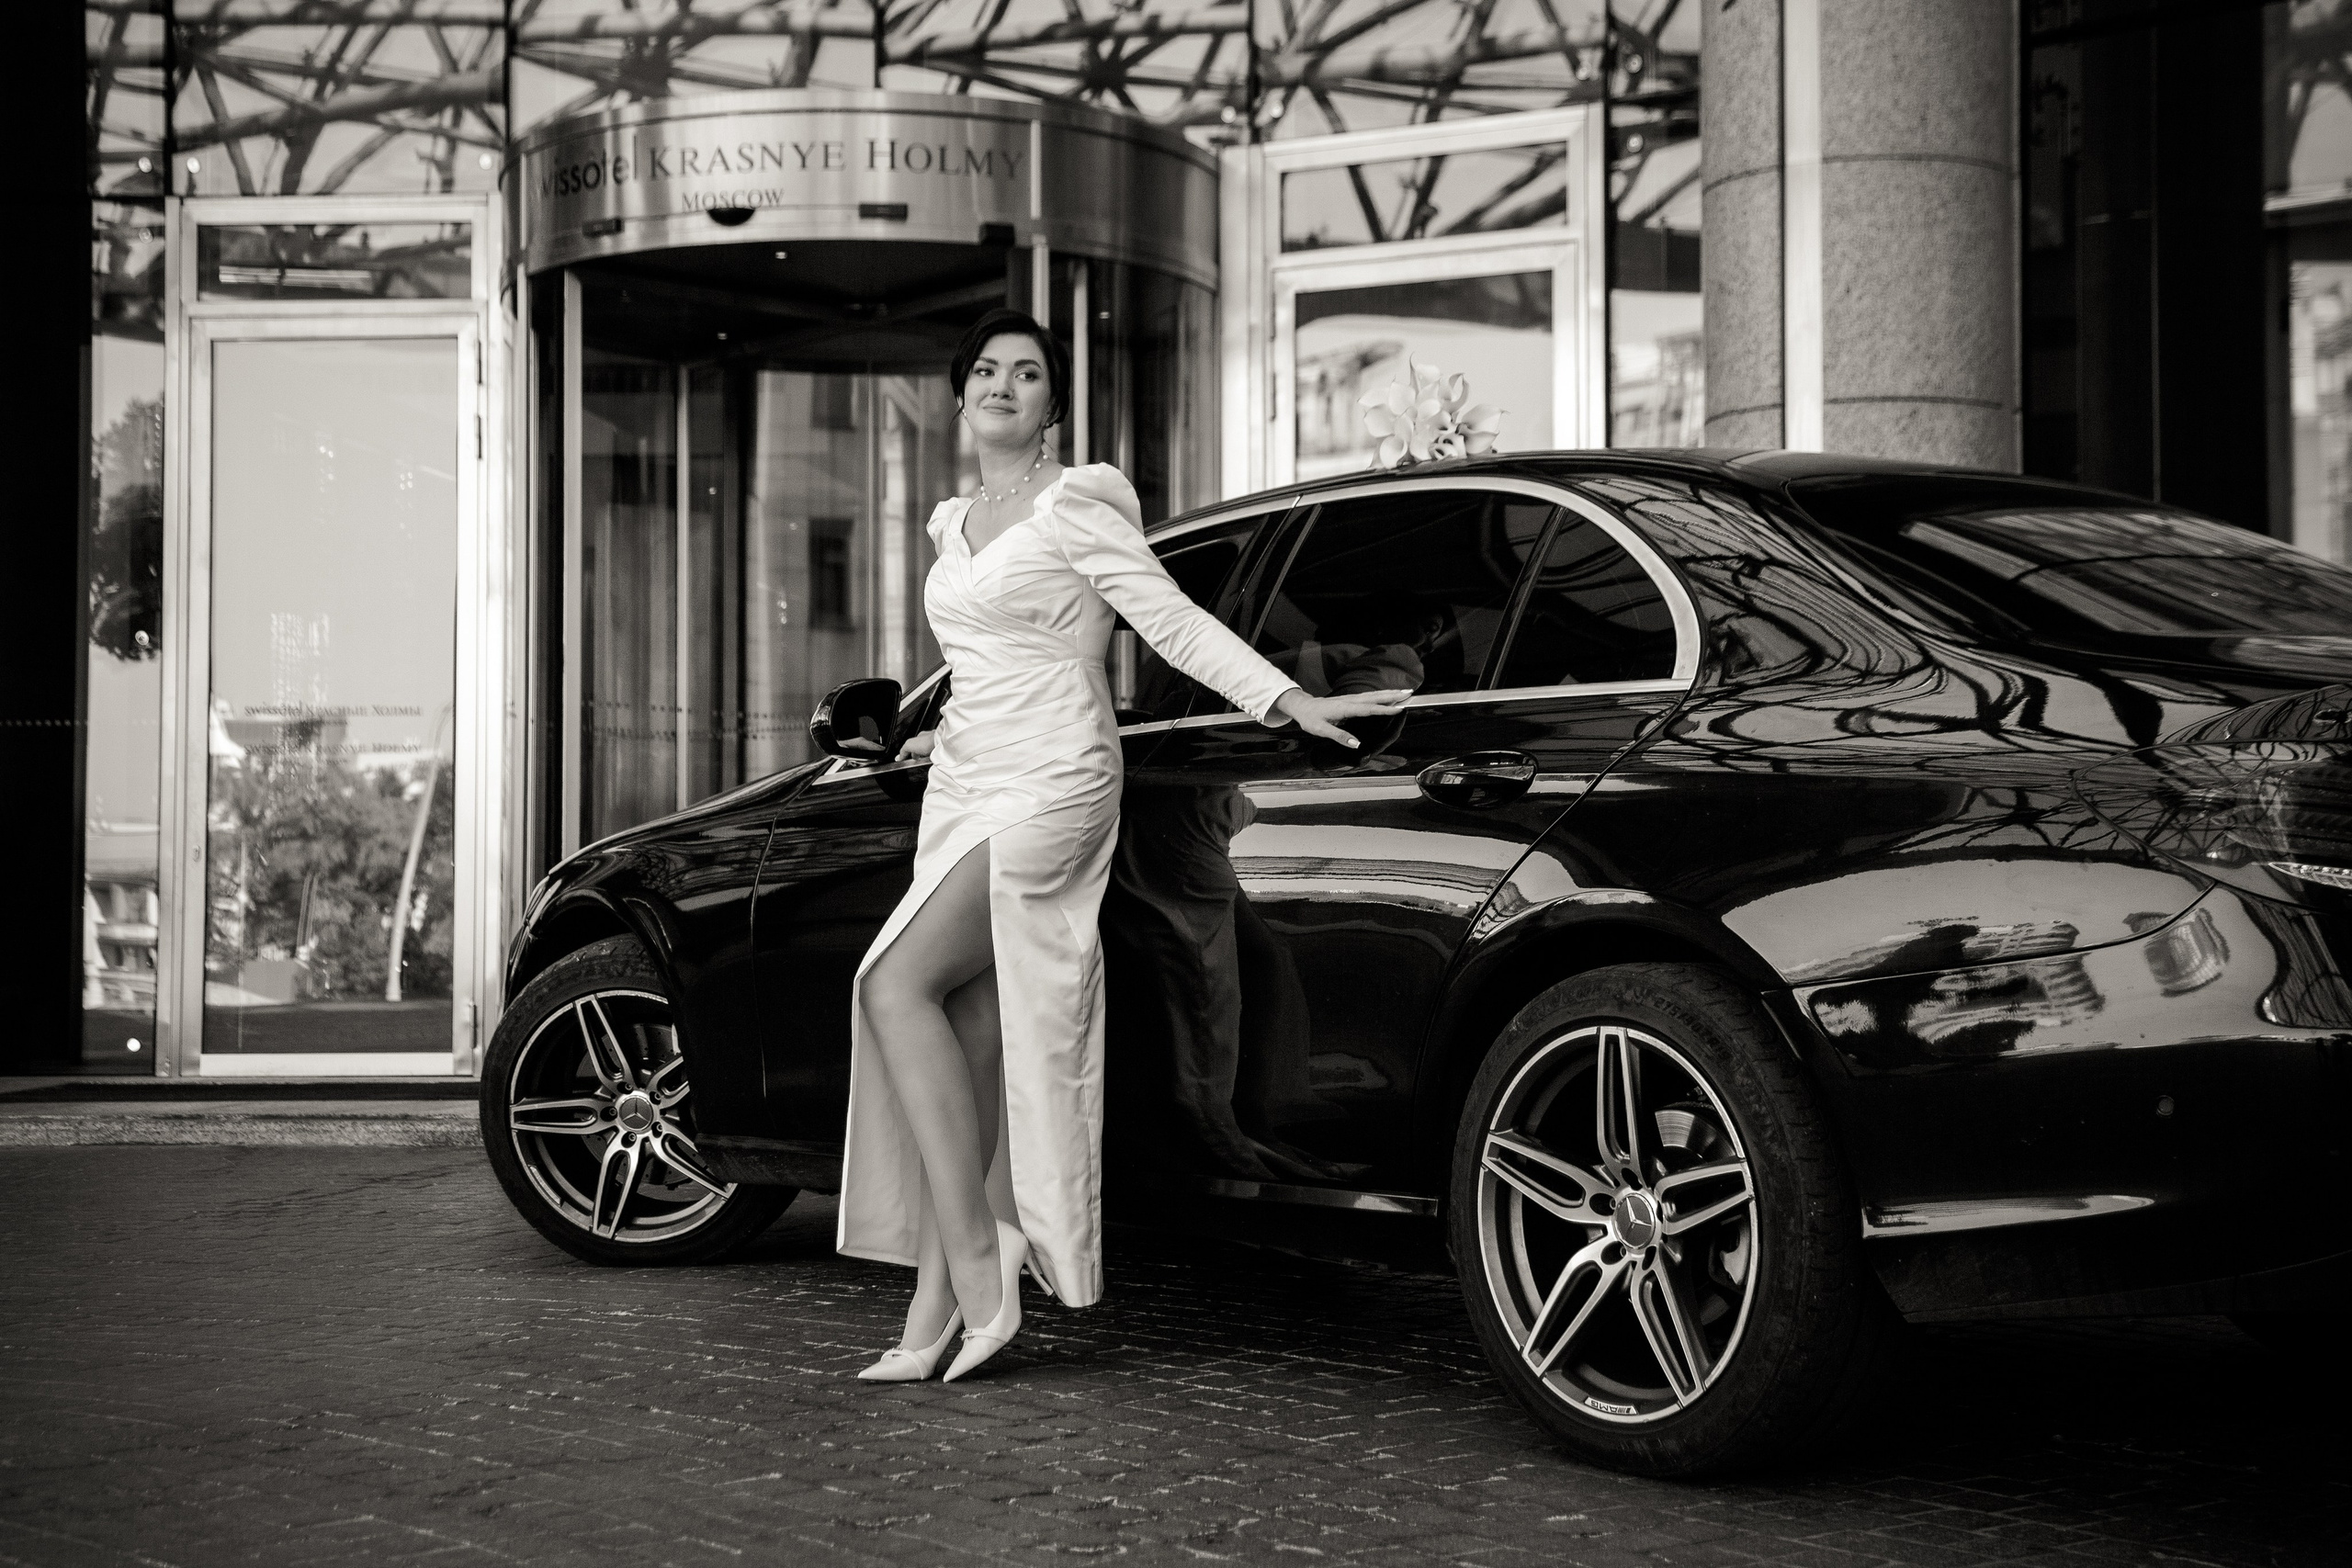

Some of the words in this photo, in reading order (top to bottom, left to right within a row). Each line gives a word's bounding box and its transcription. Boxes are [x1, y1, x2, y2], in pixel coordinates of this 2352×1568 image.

[649, 141, 846, 181] KRASNYE
[866, 140, 1023, 180] HOLMY
[681, 186, 785, 212] MOSCOW
[1590, 1399, 1618, 1413] AMG
